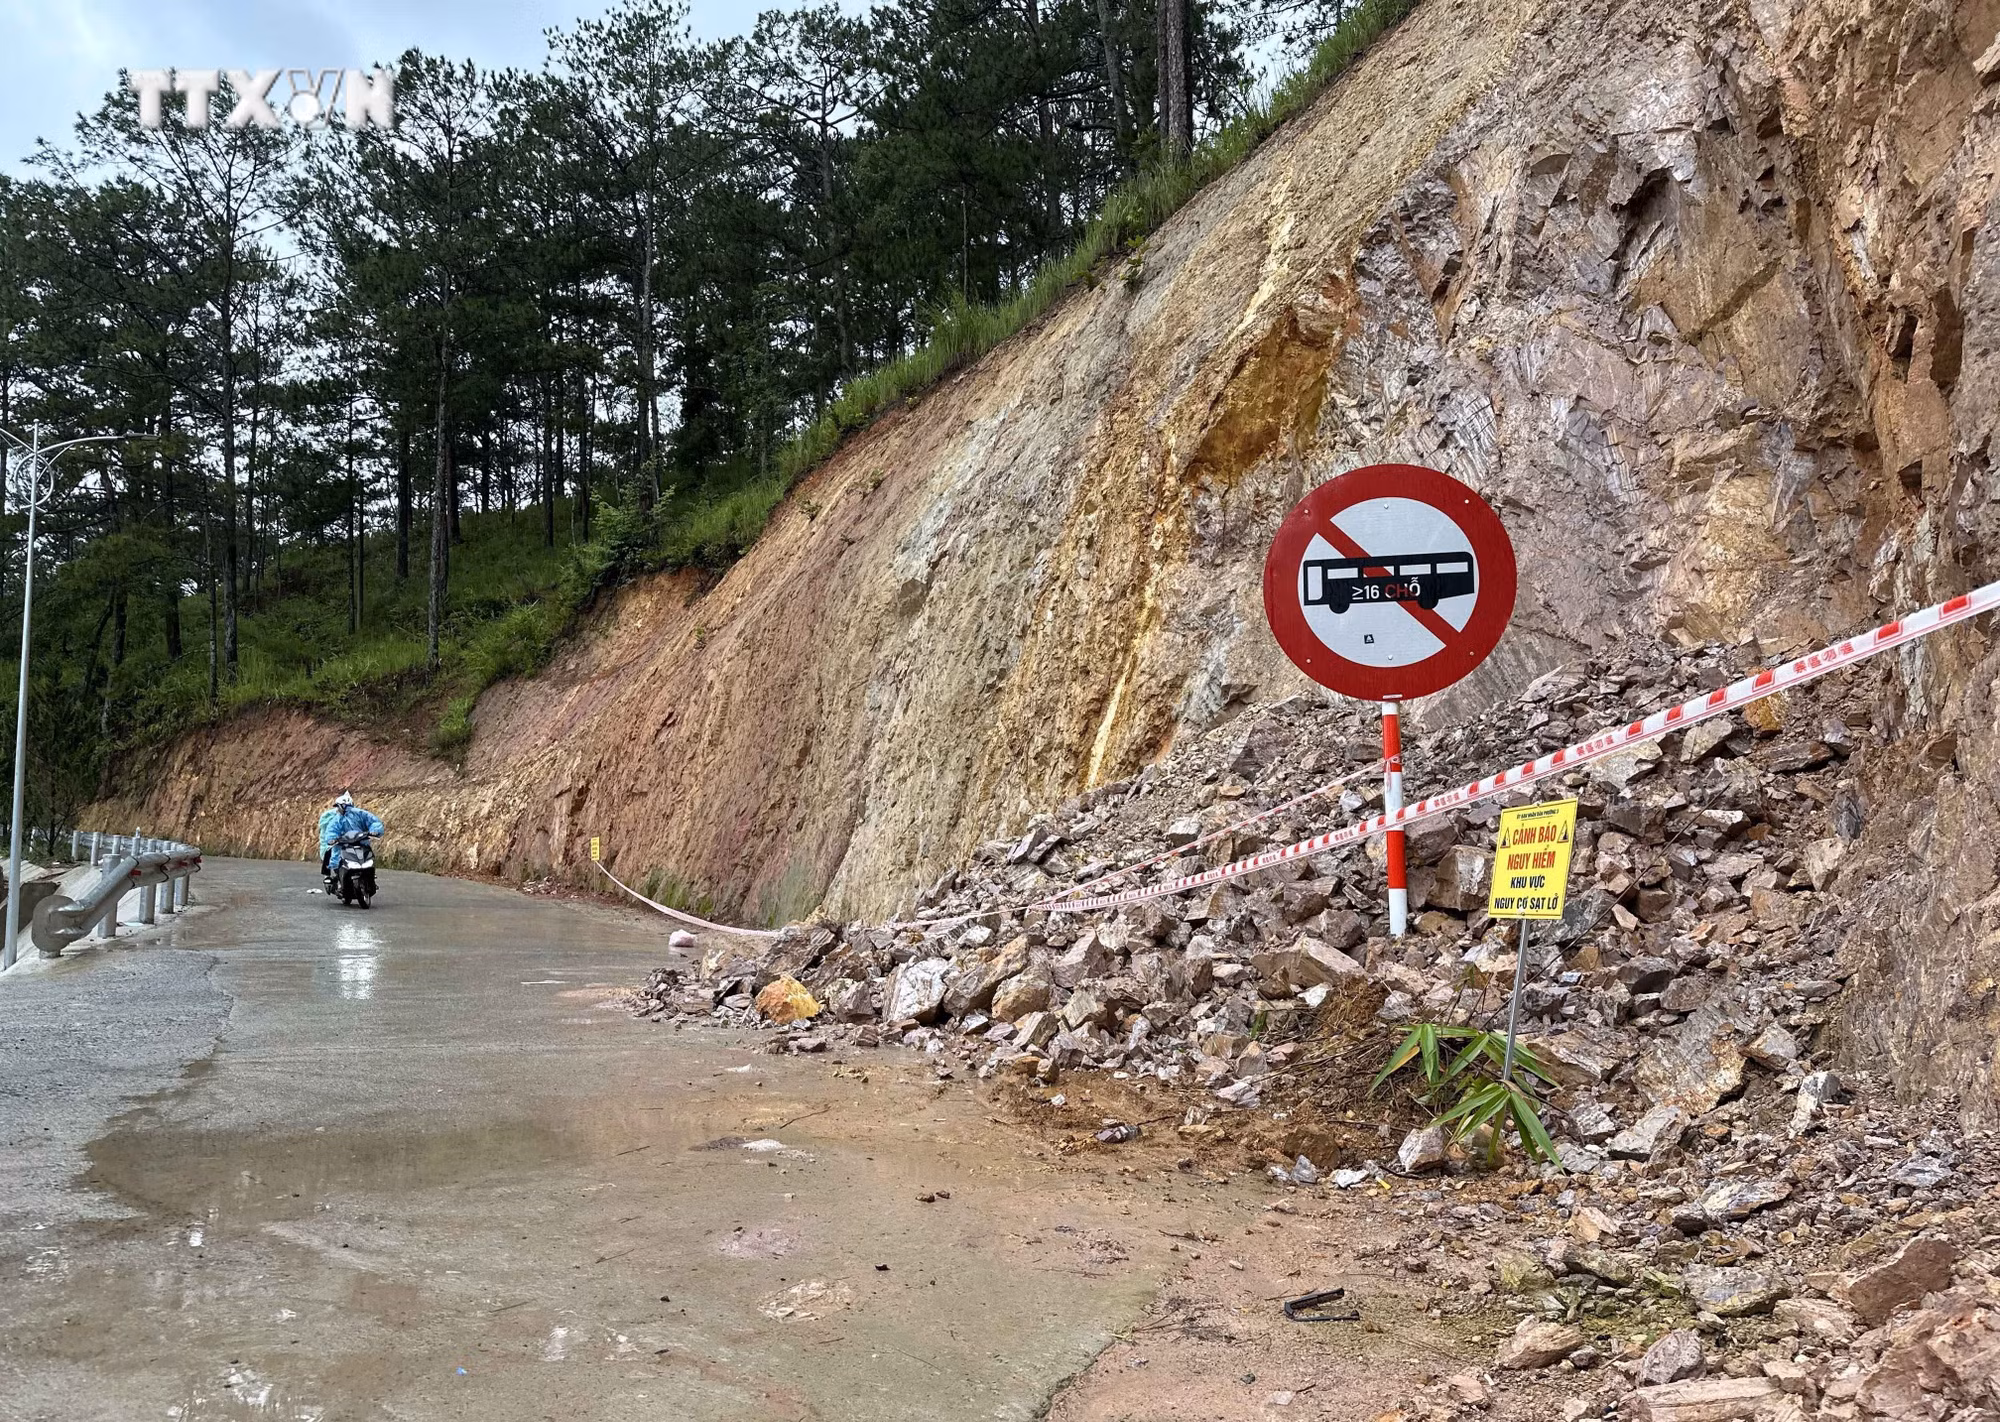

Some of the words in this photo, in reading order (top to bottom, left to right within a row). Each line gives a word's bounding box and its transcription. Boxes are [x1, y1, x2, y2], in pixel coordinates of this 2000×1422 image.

[1384, 576, 1421, 599] CHỖ
[1512, 822, 1537, 845] CẢNH
[1538, 821, 1557, 843] BÁO
[1507, 853, 1531, 870] NGUY
[1532, 844, 1556, 869] HIỂM
[1510, 876, 1527, 888] KHU
[1529, 874, 1545, 891] VỰC
[1494, 897, 1515, 909] NGUY
[1516, 896, 1529, 909] CƠ
[1529, 897, 1546, 912] SẠT
[1547, 892, 1559, 910] LỞ
